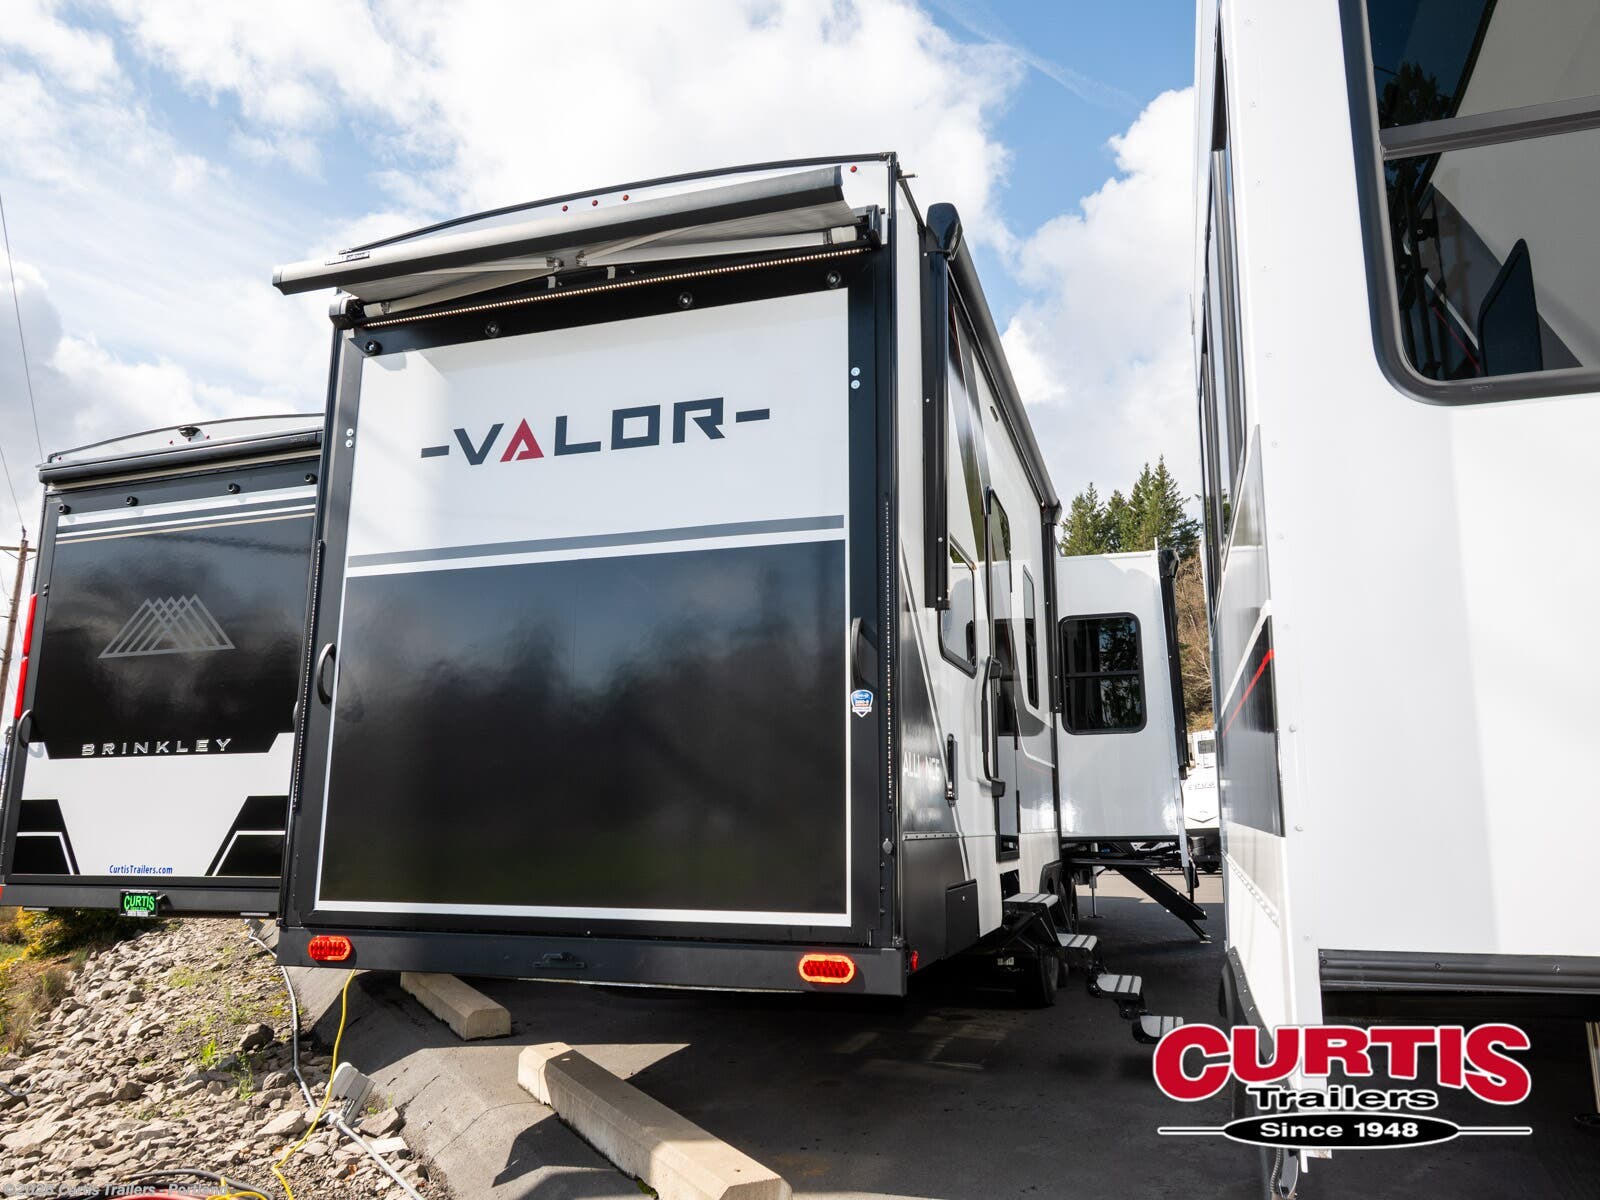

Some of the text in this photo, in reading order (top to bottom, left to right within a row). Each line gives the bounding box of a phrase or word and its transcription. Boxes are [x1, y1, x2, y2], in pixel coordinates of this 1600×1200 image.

[81, 738, 231, 756] BRINKLEY
[109, 864, 173, 875] CurtisTrailers.com
[124, 895, 154, 911] CURTIS
